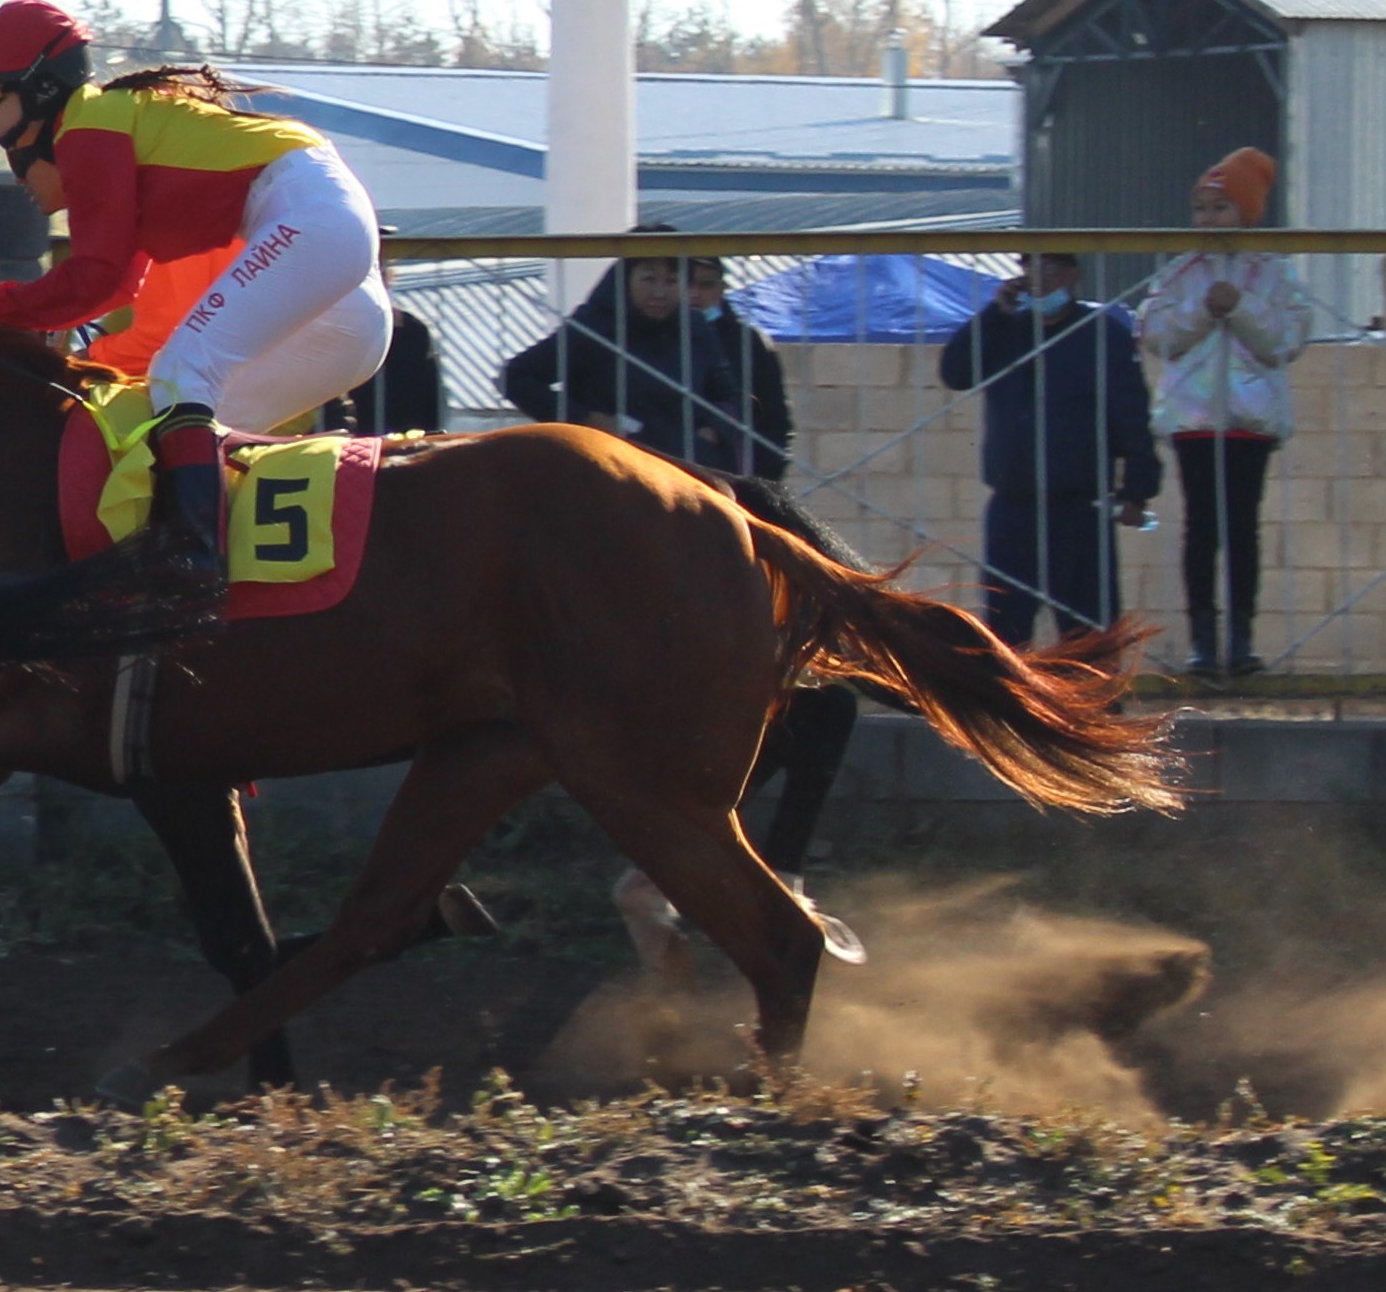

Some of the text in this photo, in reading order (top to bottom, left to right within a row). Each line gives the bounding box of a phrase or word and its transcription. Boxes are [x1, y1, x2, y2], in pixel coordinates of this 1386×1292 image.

[185, 224, 300, 333] ПКФ ЛАЙНА
[255, 477, 309, 562] 5
